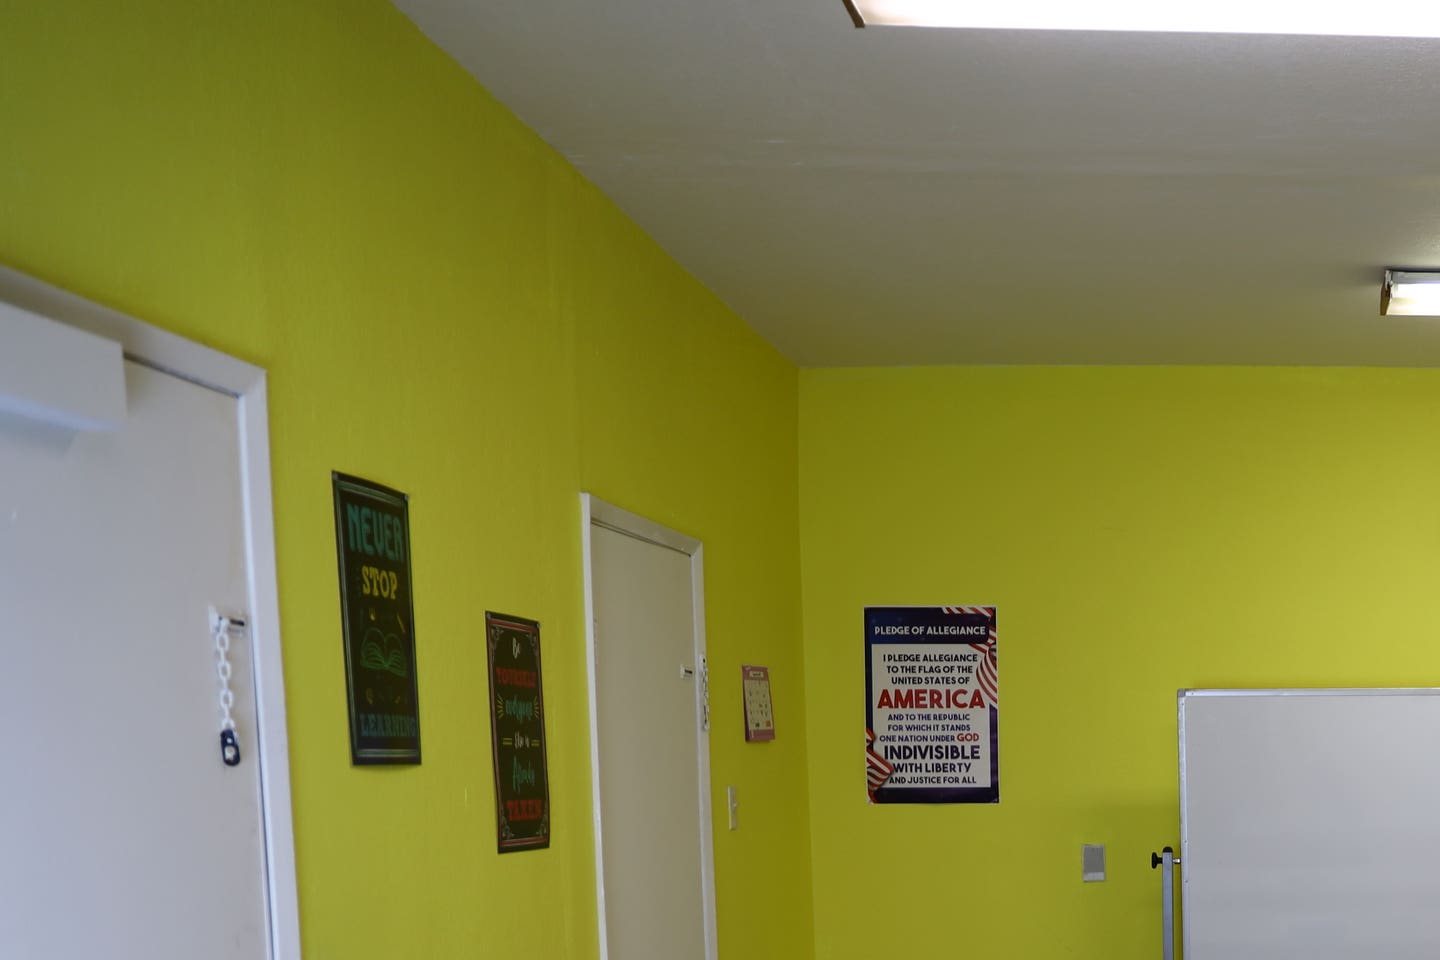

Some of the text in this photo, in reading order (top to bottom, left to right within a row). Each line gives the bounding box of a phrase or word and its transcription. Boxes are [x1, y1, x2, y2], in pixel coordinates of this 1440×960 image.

[346, 502, 404, 561] NEVER
[361, 564, 398, 600] STOP
[874, 626, 986, 636] PLEDGE OF ALLEGIANCE
[888, 654, 920, 662] PLEDGE
[922, 654, 978, 662] ALLEGIANCE
[887, 665, 973, 674] TO THE FLAG OF THE
[891, 676, 970, 685] UNITED STATES OF
[877, 689, 985, 709] AMERICA
[359, 713, 417, 739] LEARNING
[957, 733, 980, 742] GOD
[884, 745, 981, 760] INDIVISIBLE
[893, 763, 971, 773] WITH LIBERTY
[889, 776, 976, 784] AND JUSTICE FOR ALL
